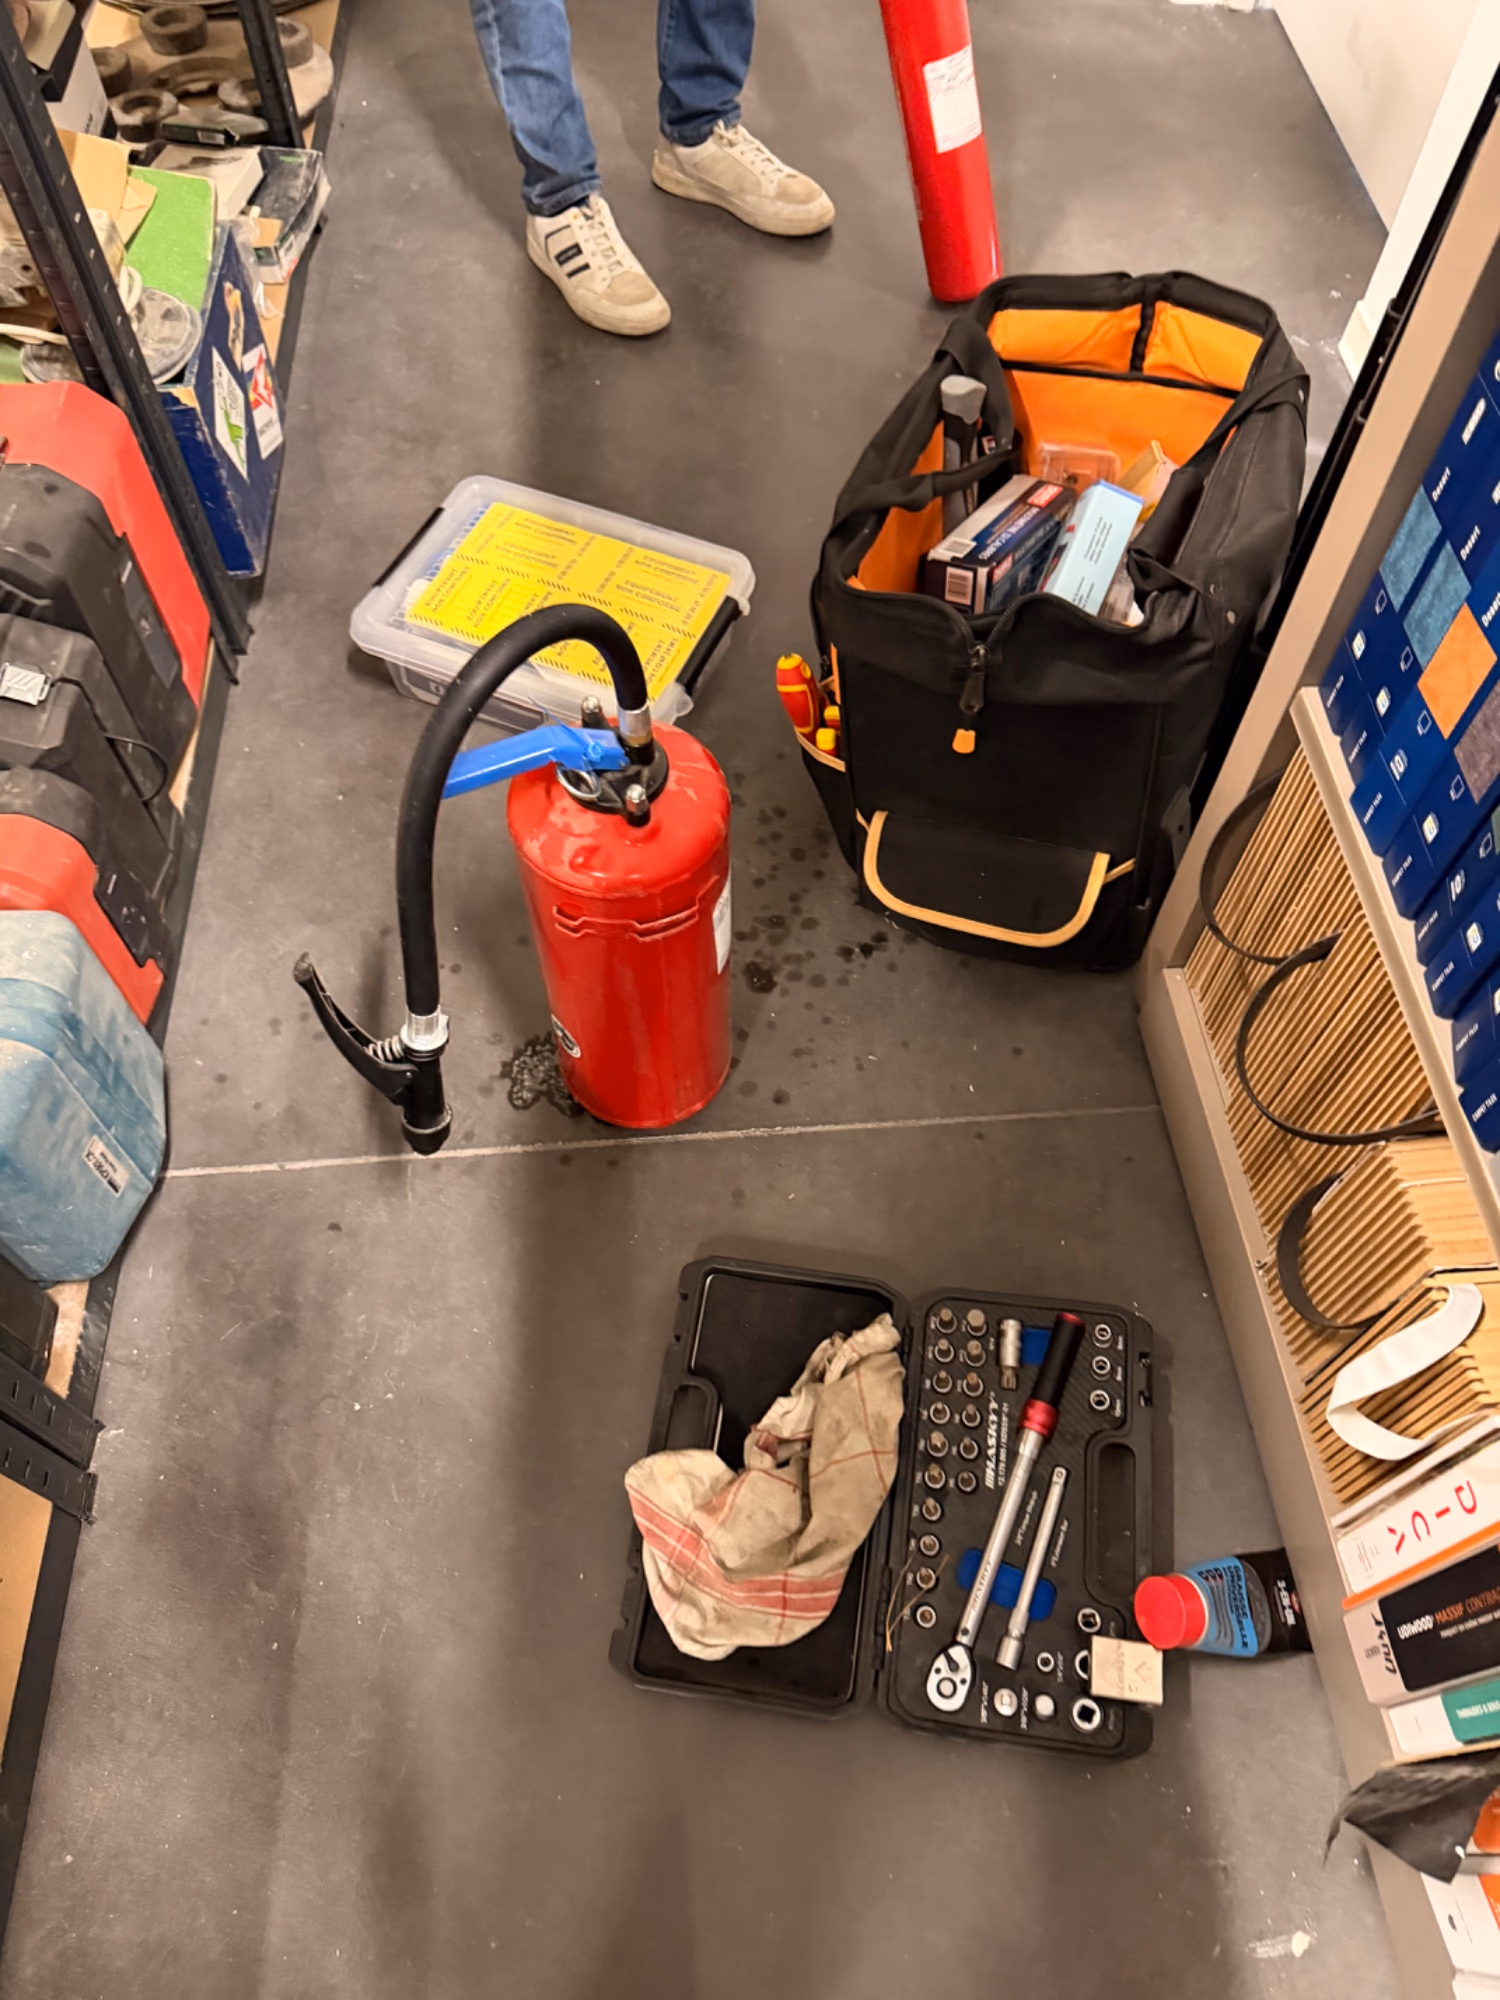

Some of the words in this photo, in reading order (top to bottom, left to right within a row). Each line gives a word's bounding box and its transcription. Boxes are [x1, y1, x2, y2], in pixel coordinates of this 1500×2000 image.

[1431, 466, 1451, 502] Desert
[1460, 525, 1481, 562] Desert
[1434, 1602, 1464, 1625] MASSIF
